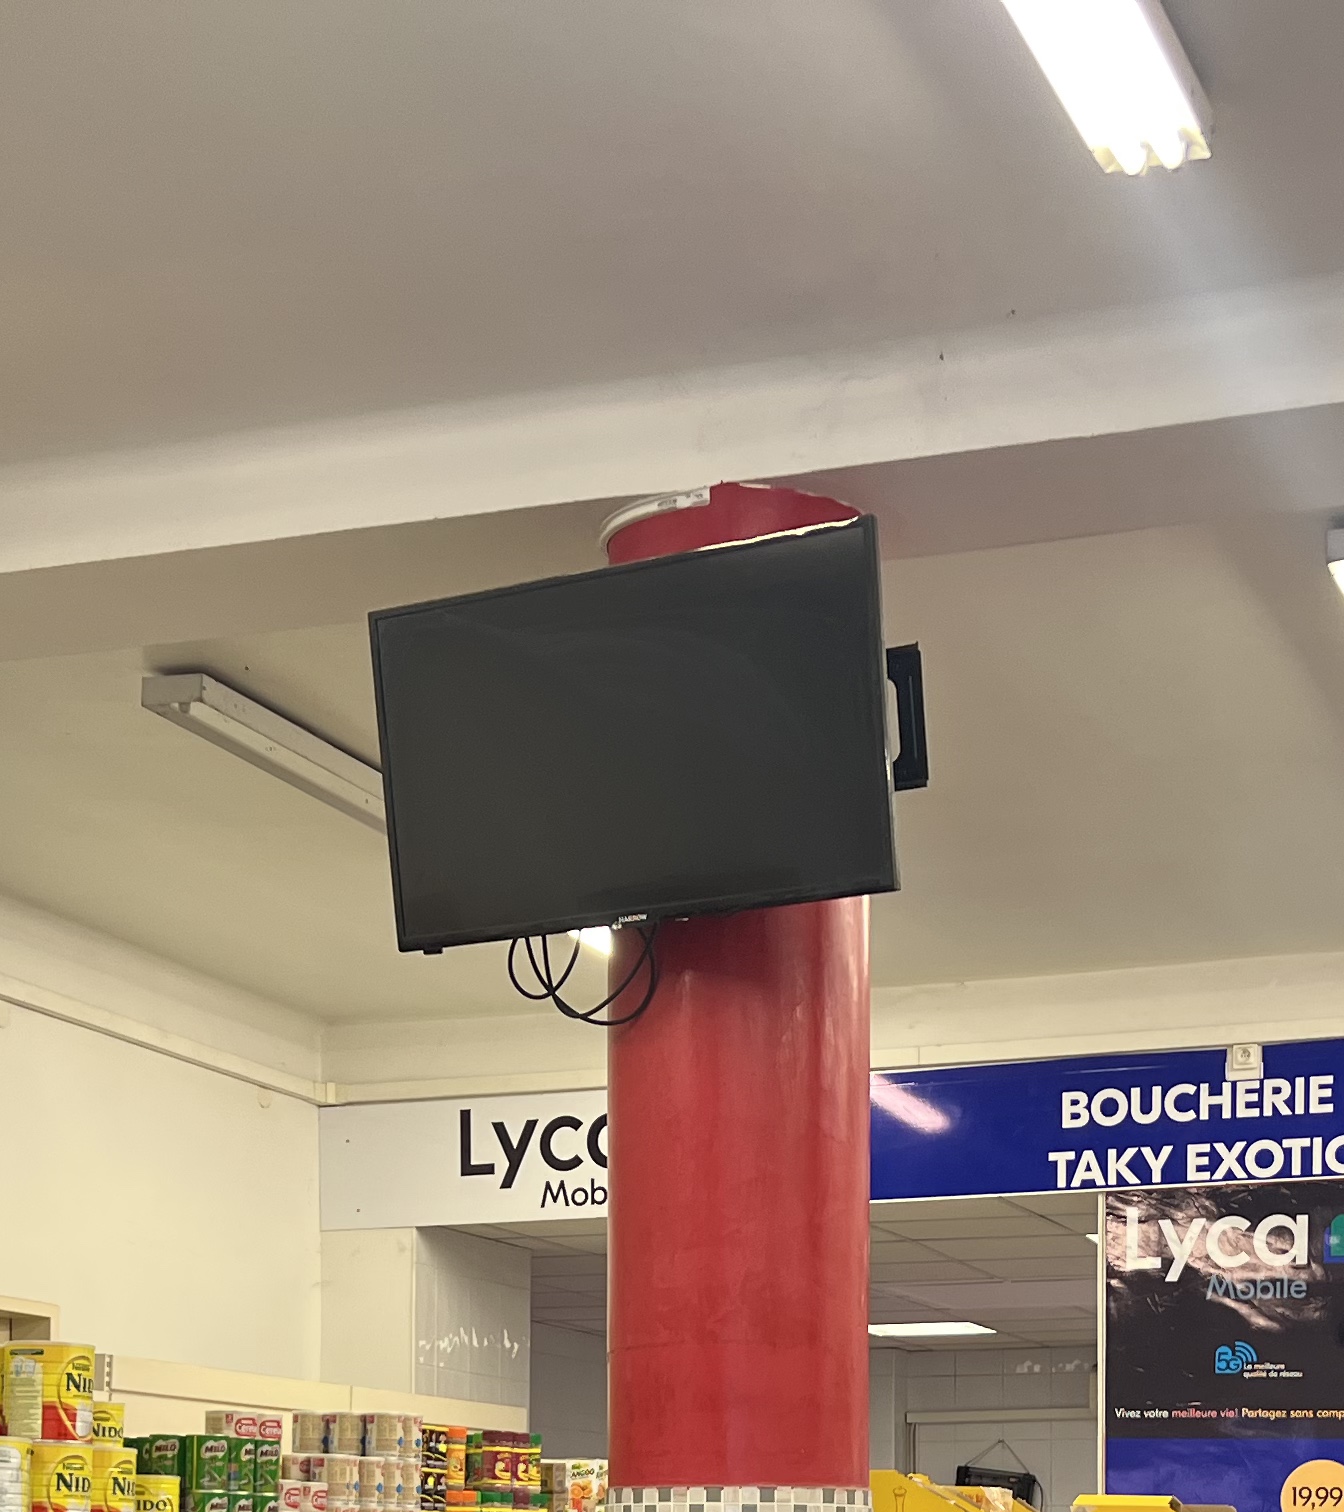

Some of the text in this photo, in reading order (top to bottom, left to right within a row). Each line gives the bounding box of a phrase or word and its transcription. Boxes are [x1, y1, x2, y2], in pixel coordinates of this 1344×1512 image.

[1061, 1075, 1334, 1129] BOUCHERIE
[1048, 1145, 1173, 1188] TAKY
[540, 1178, 608, 1208] Mob
[1125, 1207, 1309, 1282] Lyca
[1206, 1276, 1307, 1300] Mobile
[1216, 1352, 1240, 1372] 5G
[1254, 1361, 1286, 1370] meilleure
[65, 1372, 94, 1394] NID
[1114, 1407, 1141, 1418] Vivez
[1143, 1409, 1169, 1418] votre
[1171, 1407, 1218, 1418] meilleure
[1241, 1407, 1287, 1420] Partagez
[1289, 1409, 1314, 1418] sans
[56, 1472, 92, 1494] NID
[136, 1499, 168, 1512] IDO
